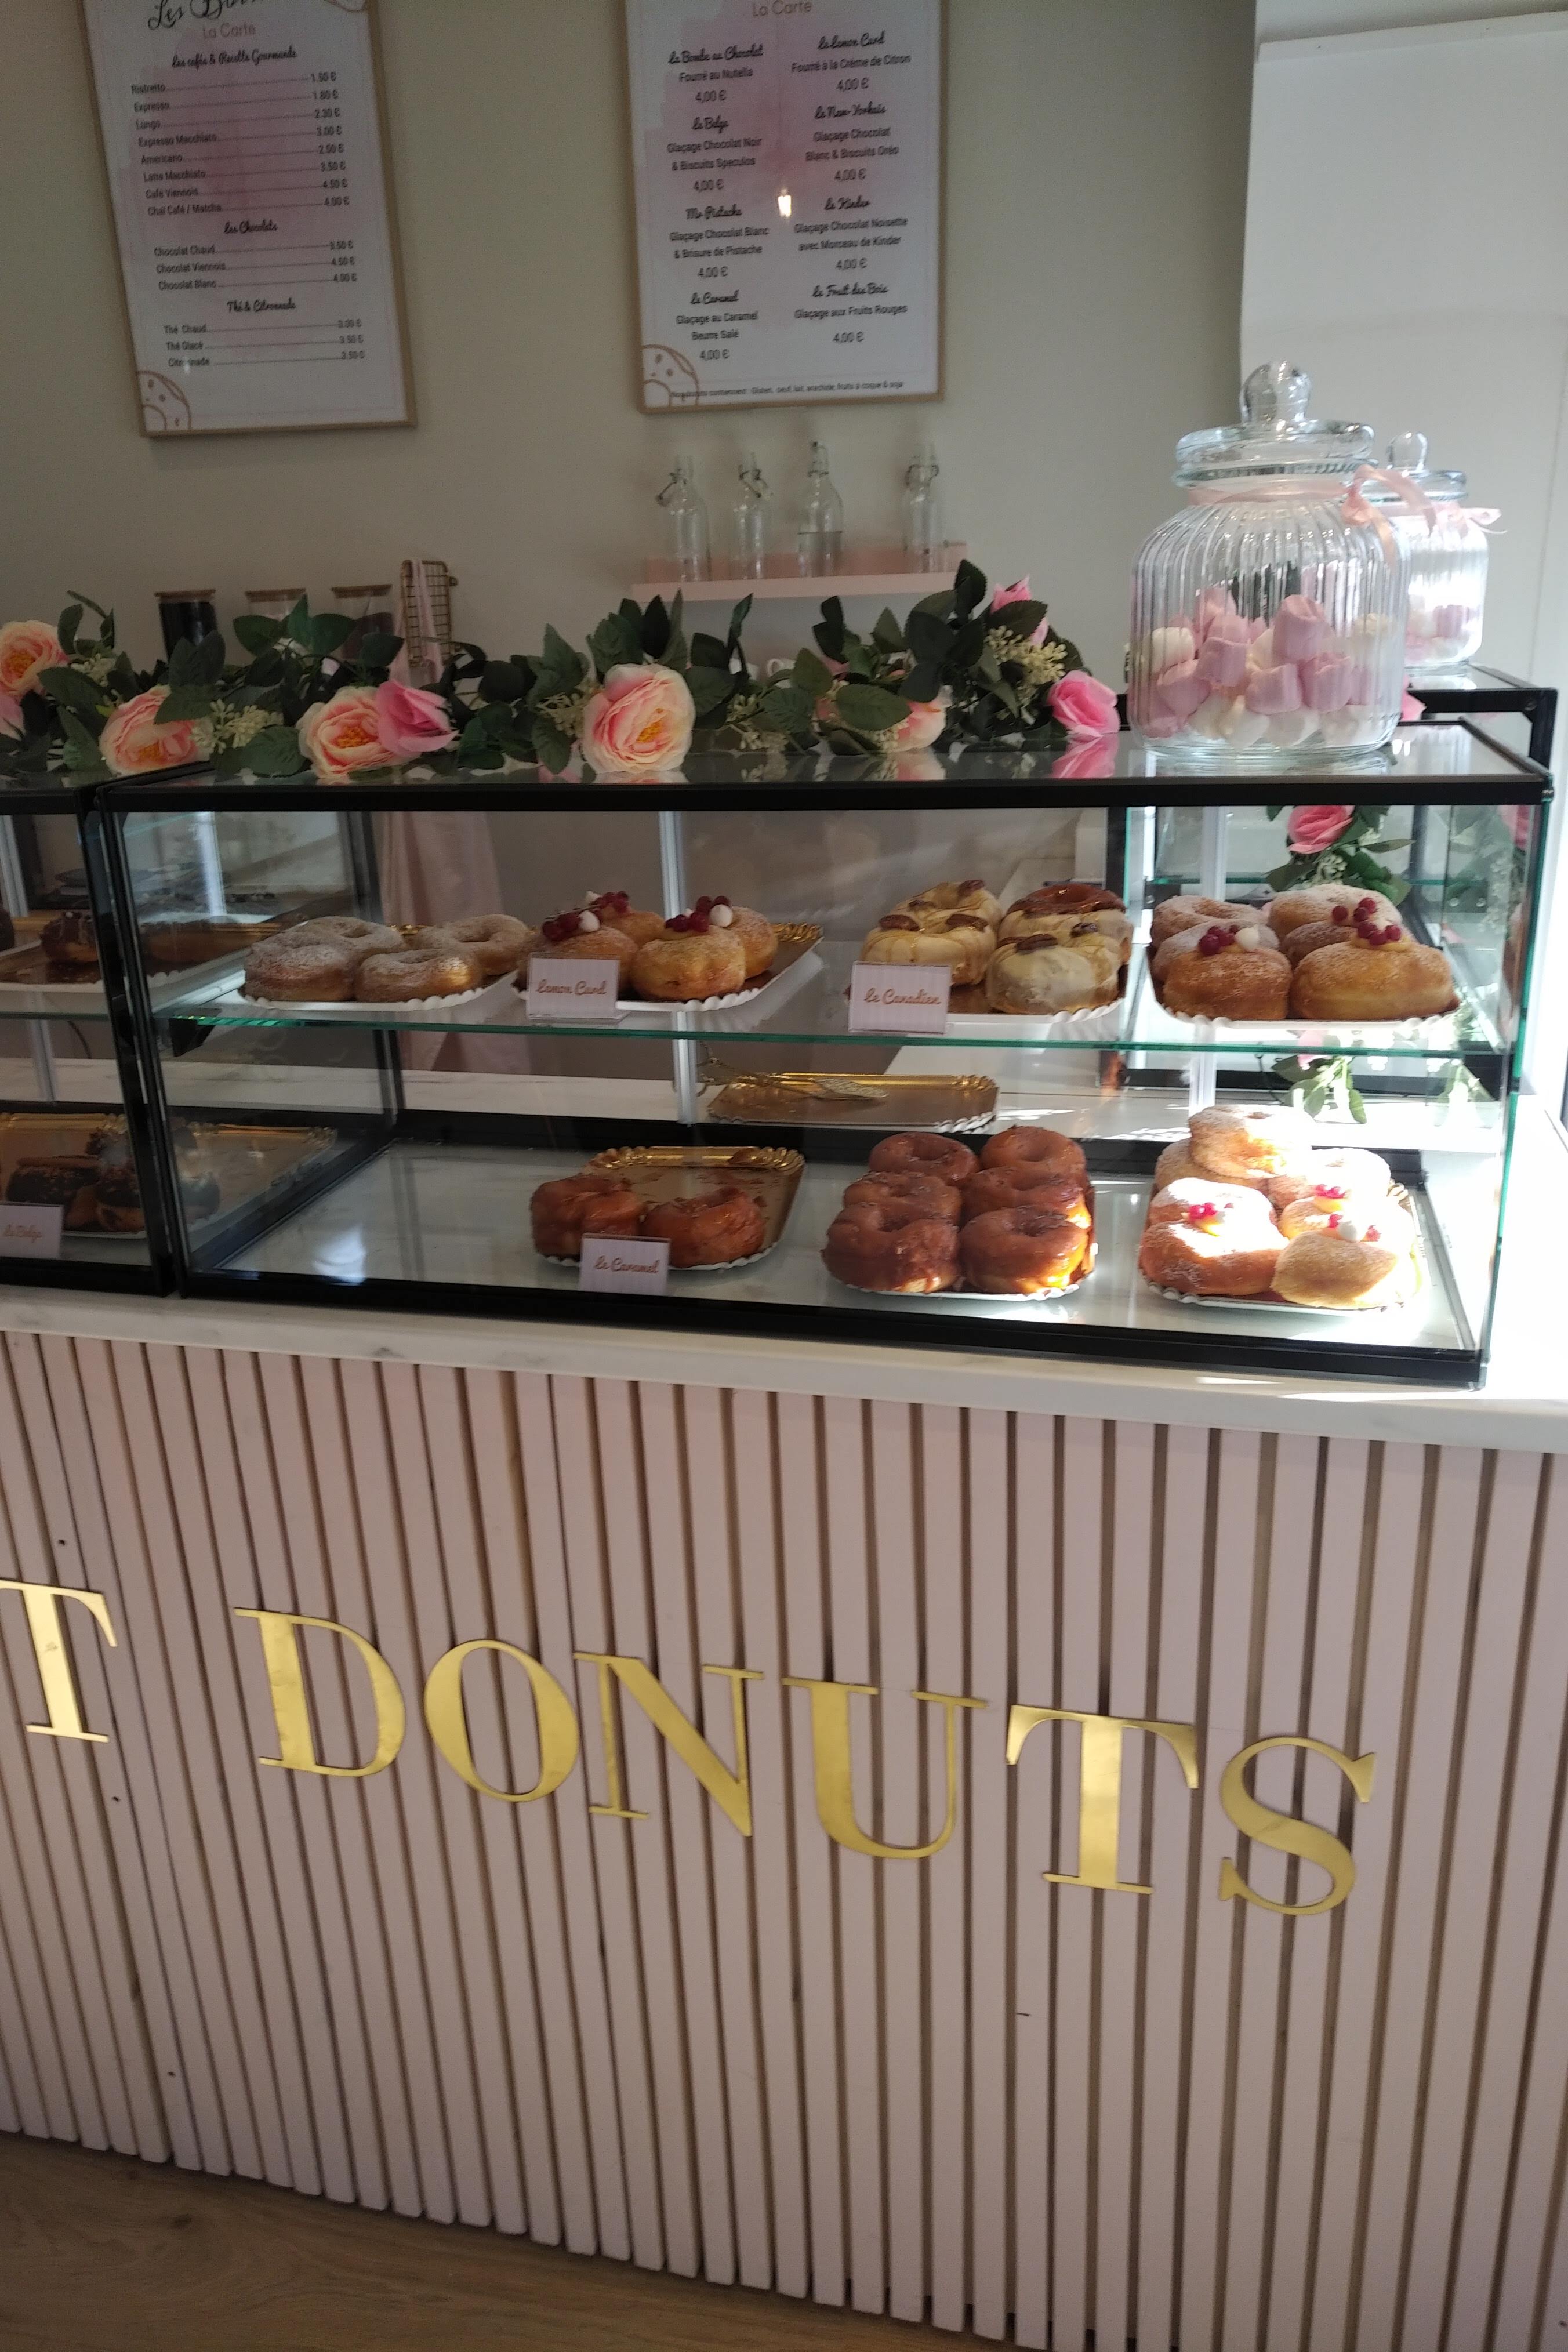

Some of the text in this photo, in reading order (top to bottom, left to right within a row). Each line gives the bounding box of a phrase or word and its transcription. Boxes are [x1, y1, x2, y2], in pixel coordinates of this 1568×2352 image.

[752, 0, 812, 16] La Carte
[203, 23, 256, 39] La Carte
[724, 43, 764, 60] Chocolat
[870, 56, 881, 66] de
[721, 67, 753, 78] Nutella
[836, 78, 859, 92] 4,00
[695, 90, 717, 103] 4,00
[133, 101, 170, 113] Expresso
[136, 119, 161, 130] Lungo
[138, 136, 175, 148] Expresso
[176, 132, 217, 145] Macchiato
[813, 127, 891, 143] Glaçage Chocolat
[667, 136, 762, 154] Glaçage Chocolat Noir
[141, 154, 183, 165] Americano
[805, 150, 830, 162] Blanc
[840, 147, 876, 159] Biscuits
[680, 158, 714, 171] Biscuits
[143, 172, 164, 182] Latte
[165, 168, 206, 180] Macchiato
[834, 169, 856, 182] 4,00
[145, 188, 164, 199] Café
[165, 187, 198, 198] Viennois
[693, 179, 714, 193] 4,00
[166, 204, 184, 215] Café
[192, 202, 222, 214] Matcha
[704, 204, 743, 220] Pistache
[239, 219, 278, 234] Chocolats
[793, 223, 829, 235] Glaçage
[830, 219, 869, 231] Chocolat
[669, 226, 770, 242] Glaçage Chocolat Blanc
[859, 236, 870, 248] de
[872, 235, 902, 246] Kinder
[154, 246, 188, 257] Chocolat
[190, 244, 215, 256] Chaud
[713, 246, 724, 256] de
[725, 244, 763, 256] Pistache
[156, 263, 190, 274] Chocolat
[192, 260, 226, 272] Viennois
[836, 258, 858, 271] 4,00
[697, 266, 719, 279] 4,00
[158, 280, 193, 291] Chocolat
[194, 278, 217, 289] Blanc
[702, 289, 740, 305] Caramel
[227, 299, 243, 313] Thé
[793, 304, 909, 320] Glaçage aux Fruits Rouges
[676, 315, 710, 325] Glaçage
[723, 310, 760, 322] Caramel
[164, 324, 179, 335] Thé
[182, 322, 206, 334] Chaud
[691, 329, 740, 341] Beurre Salé
[166, 340, 180, 351] Thé
[182, 340, 204, 351] Glacé
[832, 332, 855, 345] 4,00
[699, 349, 721, 362] 4,00
[575, 980, 607, 996] Curd
[881, 988, 942, 1005] Canadien
[611, 1257, 660, 1274] Caramel
[234, 1607, 1377, 1915] DONUTS
